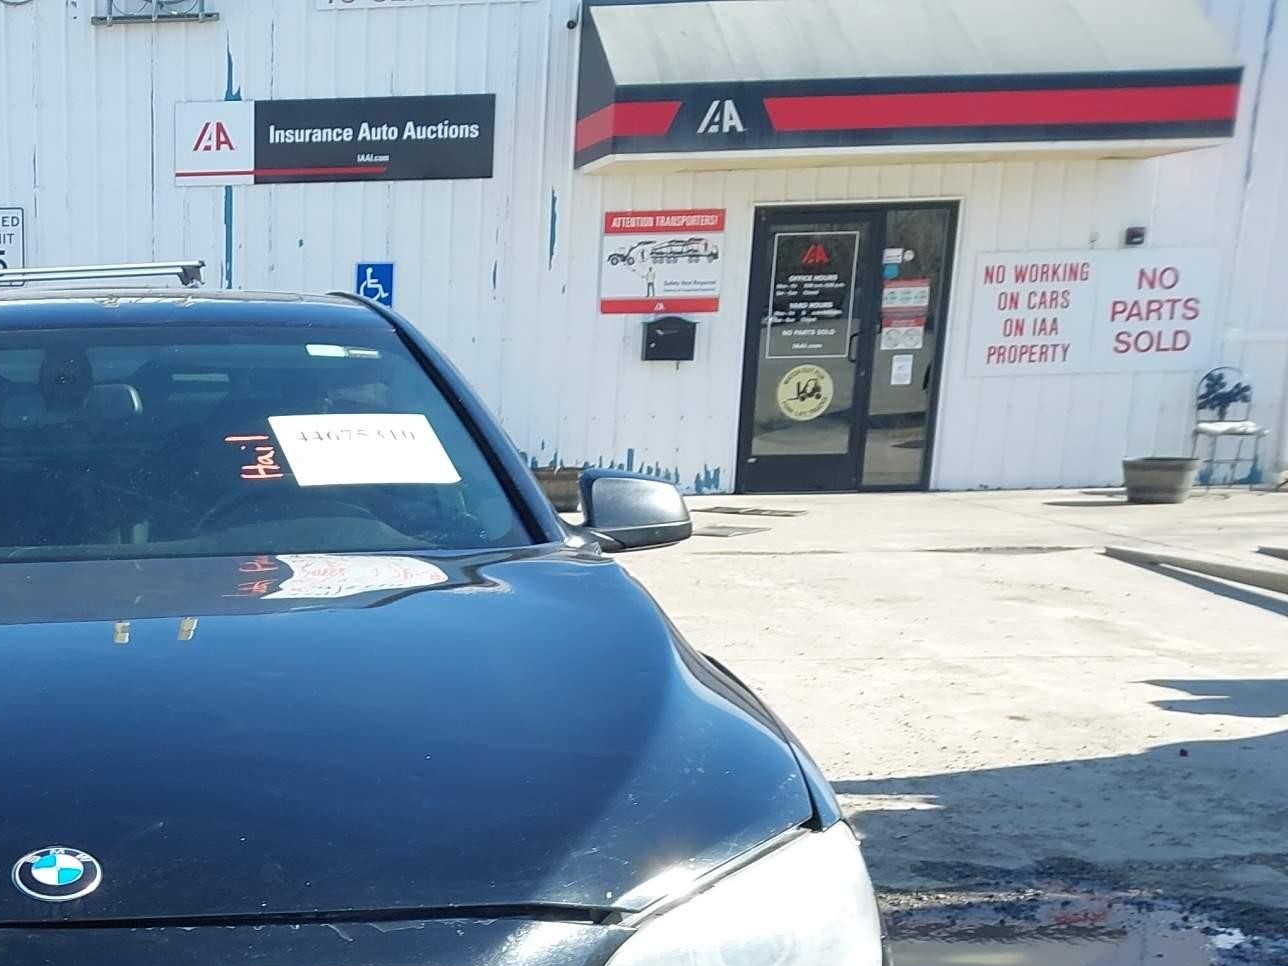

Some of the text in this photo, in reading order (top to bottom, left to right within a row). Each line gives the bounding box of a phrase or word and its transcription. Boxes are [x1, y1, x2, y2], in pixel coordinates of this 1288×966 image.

[269, 120, 480, 144] Insurance Auto Auctions
[357, 153, 390, 162] IAAI.com
[611, 216, 654, 228] ATTENTION
[984, 262, 1091, 285] NO WORKING
[1137, 266, 1180, 290] NO
[997, 289, 1071, 311] ON CARS
[1110, 297, 1200, 322] PARTS
[1003, 317, 1059, 337] ON IAA
[1113, 329, 1191, 354] SOLD
[986, 343, 1071, 364] PROPERTY
[224, 434, 285, 479] Hail
